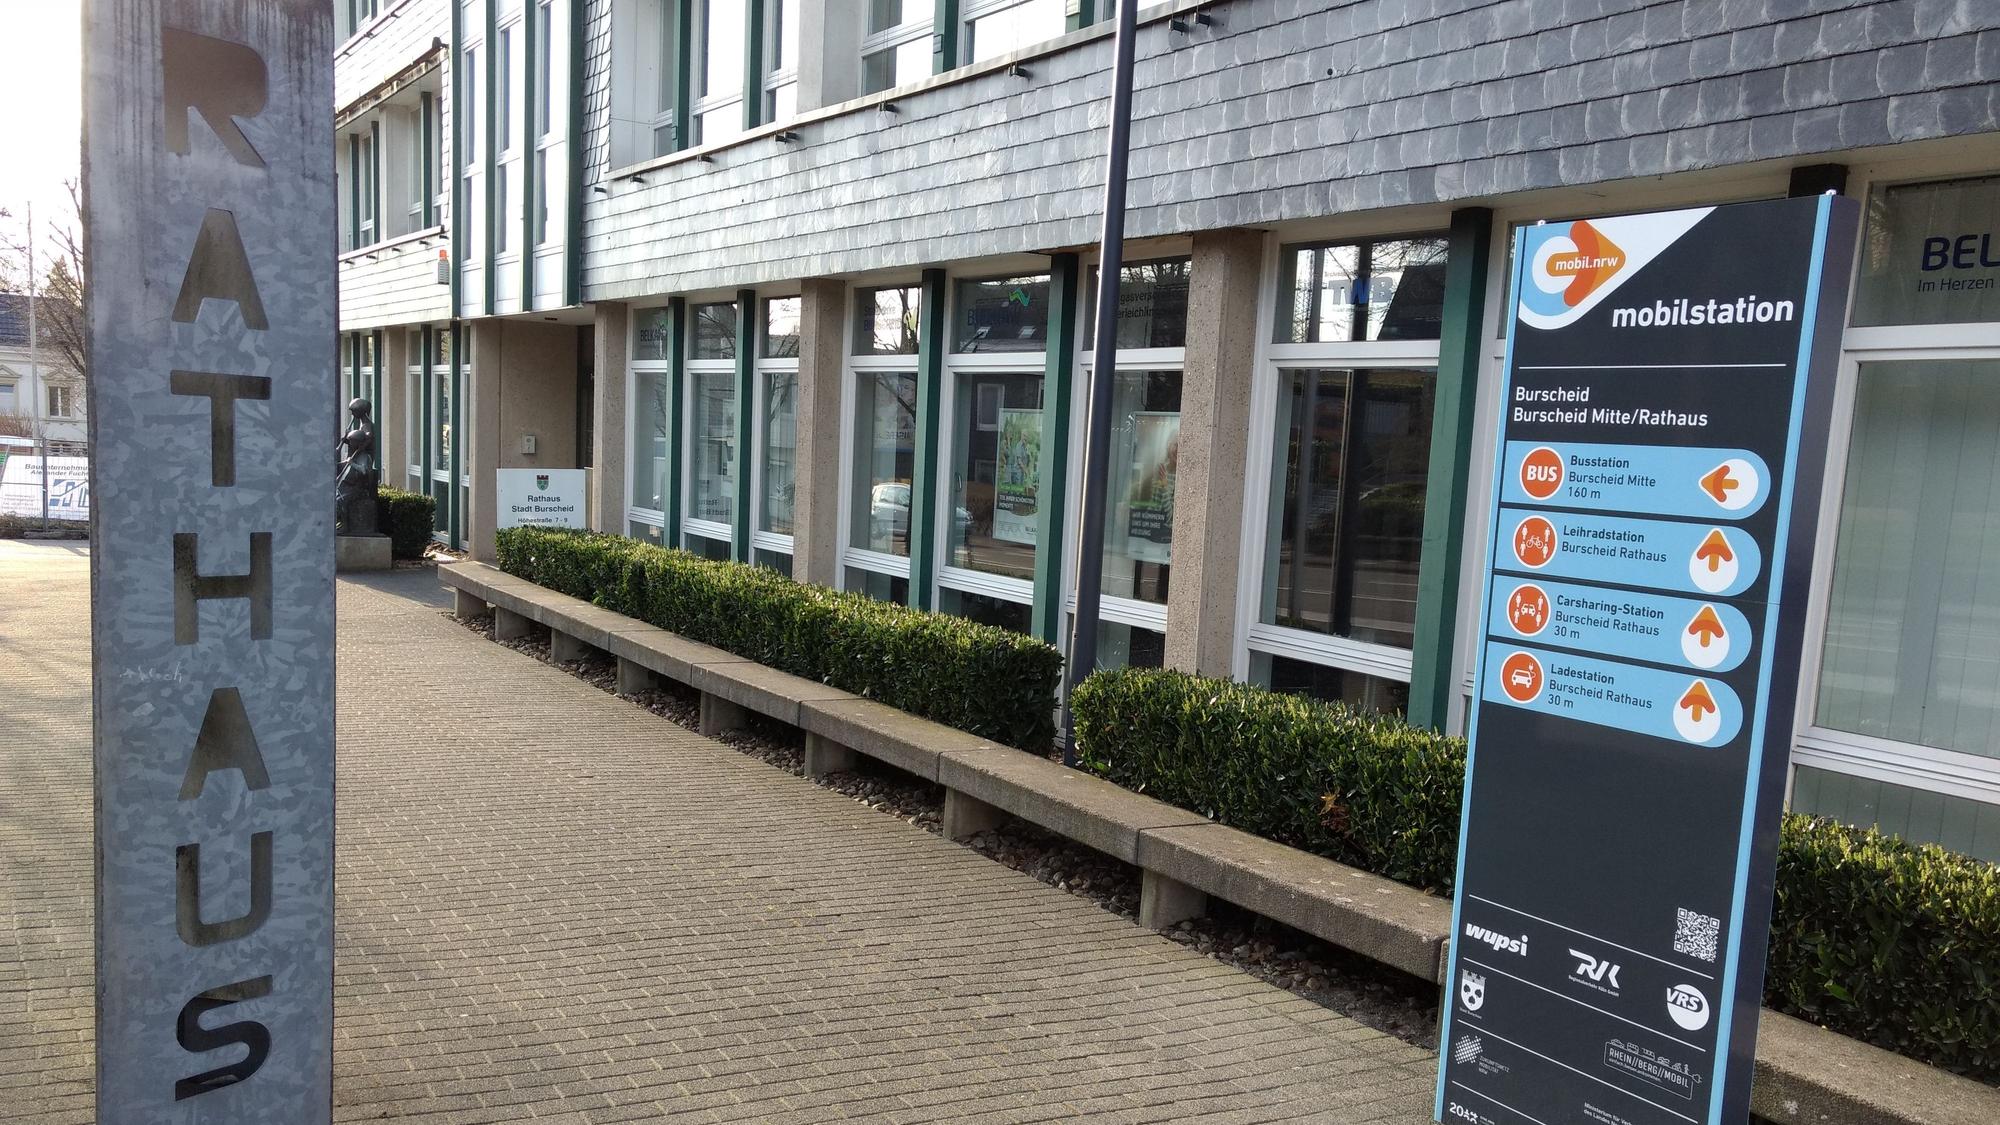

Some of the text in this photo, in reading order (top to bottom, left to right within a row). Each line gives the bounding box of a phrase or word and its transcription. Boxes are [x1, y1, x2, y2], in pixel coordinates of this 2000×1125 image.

[1555, 255, 1618, 270] mobil.nrw
[1918, 278, 1994, 292] Im Herzen
[1612, 295, 1794, 327] mobilstation
[1515, 387, 1590, 402] Burscheid
[1513, 408, 1708, 426] Burscheid Mitte/Rathaus
[1570, 455, 1630, 469] Busstation
[1526, 465, 1558, 482] BUS
[1568, 472, 1656, 487] Burscheid Mitte
[1568, 487, 1601, 499] 160 m
[511, 505, 574, 513] Stadt Burscheid
[1563, 525, 1645, 543] Leihradstation
[1561, 541, 1667, 563] Burscheid Rathaus
[162, 27, 273, 1101] RATHAUS
[1557, 594, 1665, 620] Carsharing-Station
[1554, 626, 1580, 639] 30 m
[1555, 611, 1660, 636] Burscheid Rathaus
[1551, 664, 1615, 685] Ladestation
[1548, 694, 1574, 709] 30 m
[1549, 680, 1652, 709] Burscheid Rathaus
[1465, 923, 1529, 957] wupsi
[1666, 987, 1700, 1011] VRS
[1609, 1047, 1690, 1088] RHEIN//BERG//MOBIL
